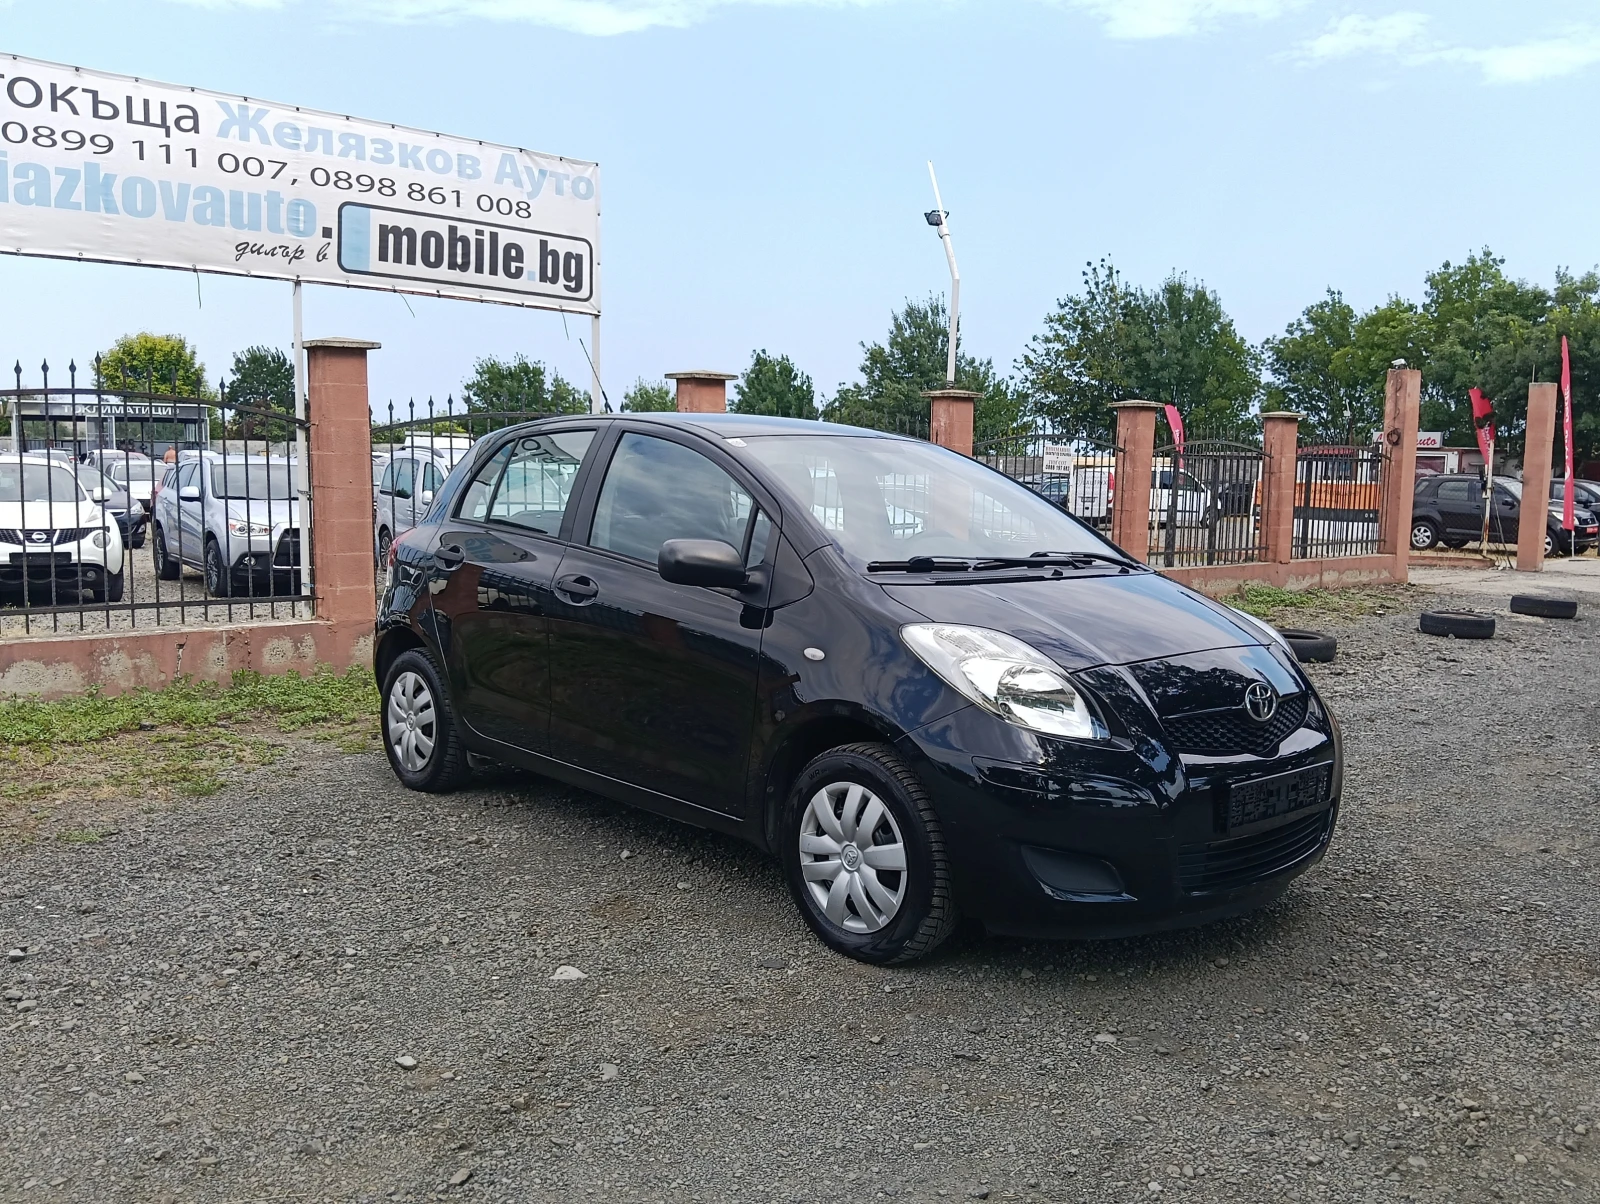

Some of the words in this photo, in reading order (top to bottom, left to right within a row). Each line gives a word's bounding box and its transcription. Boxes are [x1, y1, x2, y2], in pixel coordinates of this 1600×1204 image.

[0, 74, 200, 138] окъща
[215, 100, 482, 180] Желязков
[494, 153, 595, 200] Ауто
[1, 121, 114, 155] 0899
[132, 140, 197, 168] 111
[217, 152, 298, 185] 007,
[310, 167, 397, 197] 0898
[407, 182, 461, 208] 861
[476, 194, 532, 219] 008
[235, 241, 306, 262] дилър
[378, 223, 583, 293] mobile.bg
